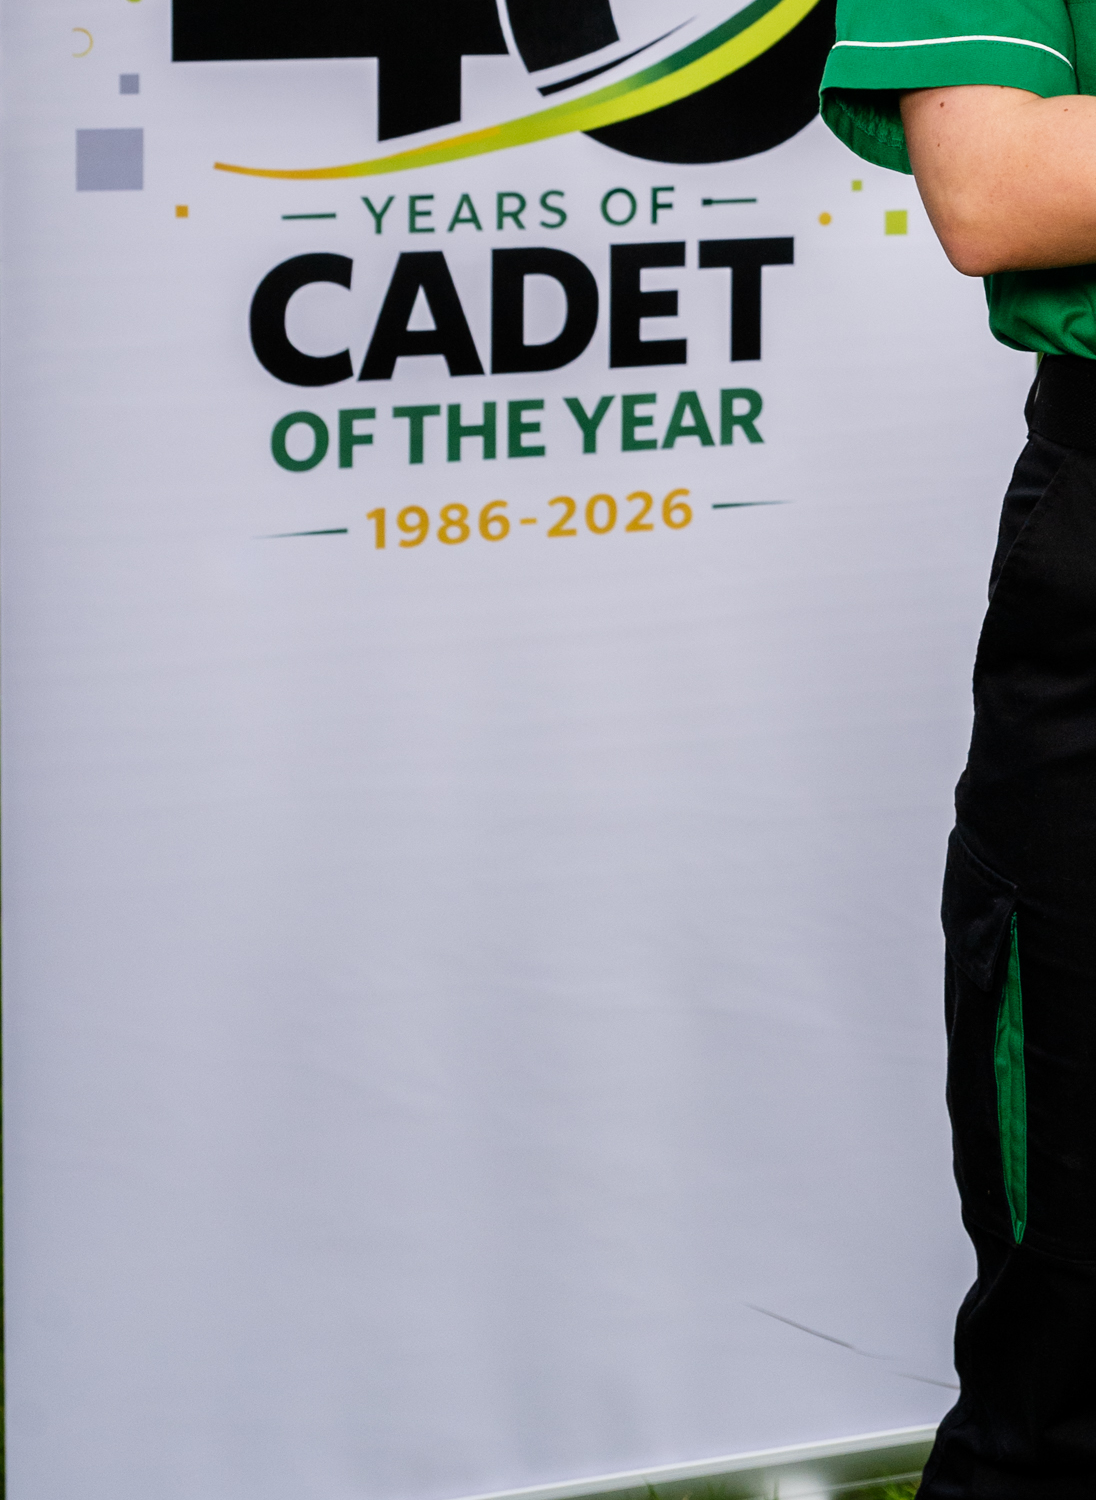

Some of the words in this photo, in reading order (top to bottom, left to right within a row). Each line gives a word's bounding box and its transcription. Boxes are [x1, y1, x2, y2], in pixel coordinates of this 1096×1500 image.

[361, 189, 568, 235] YEARS
[600, 186, 675, 226] OF
[249, 236, 795, 388] CADET
[270, 406, 377, 473] OF
[392, 398, 546, 465] THE
[563, 387, 765, 455] YEAR
[365, 487, 694, 550] 1986-2026
